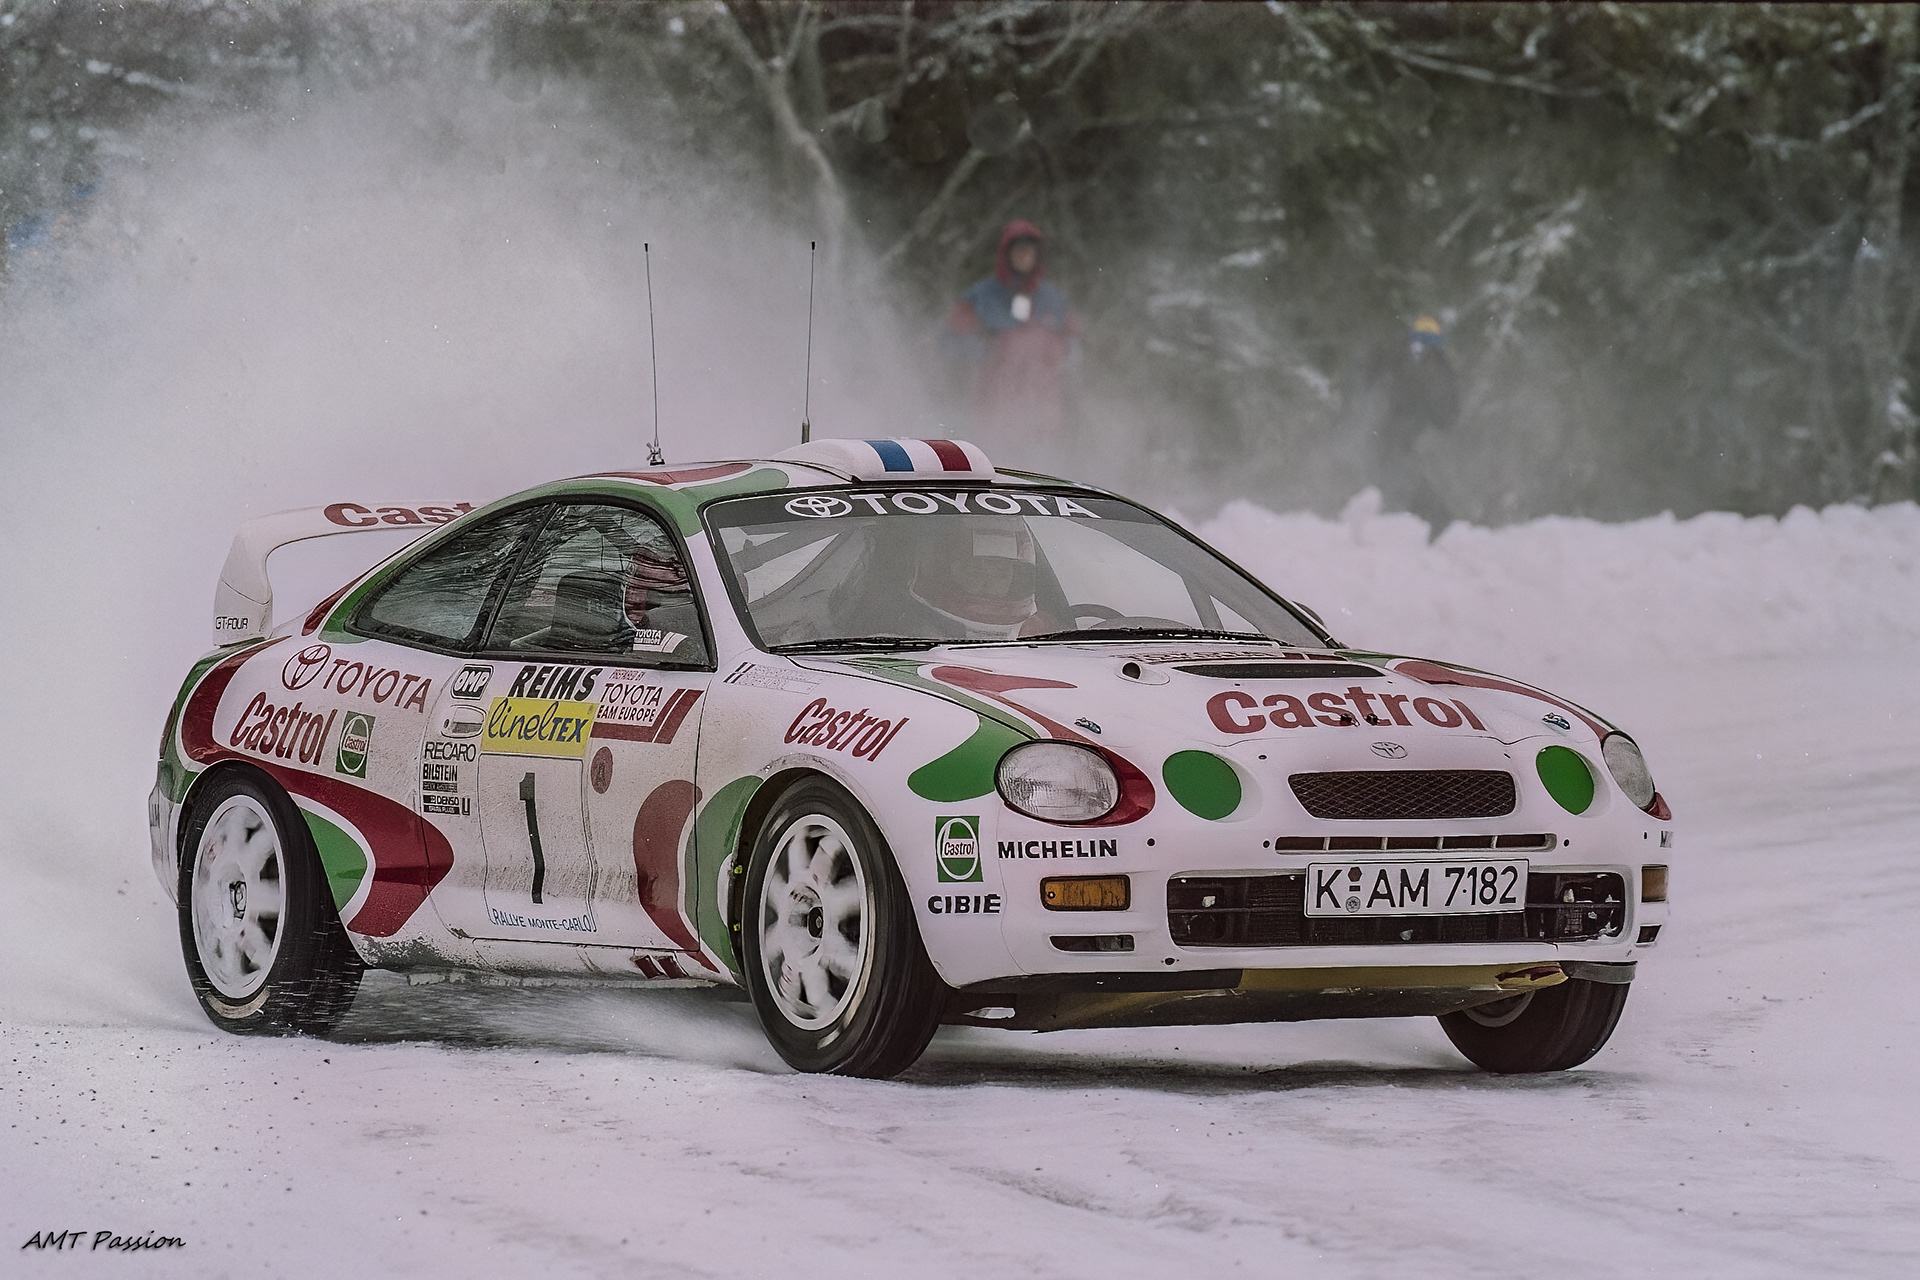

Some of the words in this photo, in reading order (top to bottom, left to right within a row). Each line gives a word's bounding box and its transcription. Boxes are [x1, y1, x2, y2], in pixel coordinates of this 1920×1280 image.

[324, 502, 477, 527] Cast
[850, 492, 1101, 519] TOYOTA
[635, 628, 662, 639] TOYOTA
[323, 658, 433, 714] TOYOTA
[453, 670, 490, 693] OMP
[507, 665, 604, 701] REIMS
[600, 682, 663, 706] TOYOTA
[596, 704, 619, 720] EAM
[618, 705, 657, 722] EUROPE
[1206, 686, 1489, 735] Castrol
[230, 691, 338, 766] Castrol
[783, 697, 910, 762] Castrol
[424, 741, 477, 763] RECARO
[422, 763, 458, 782] BILSTEIN
[519, 772, 544, 903] 1
[944, 840, 975, 857] Castrol
[998, 839, 1118, 859] MICHELIN
[492, 908, 526, 928] RALLYE
[528, 914, 590, 932] MONTE-CARLO
